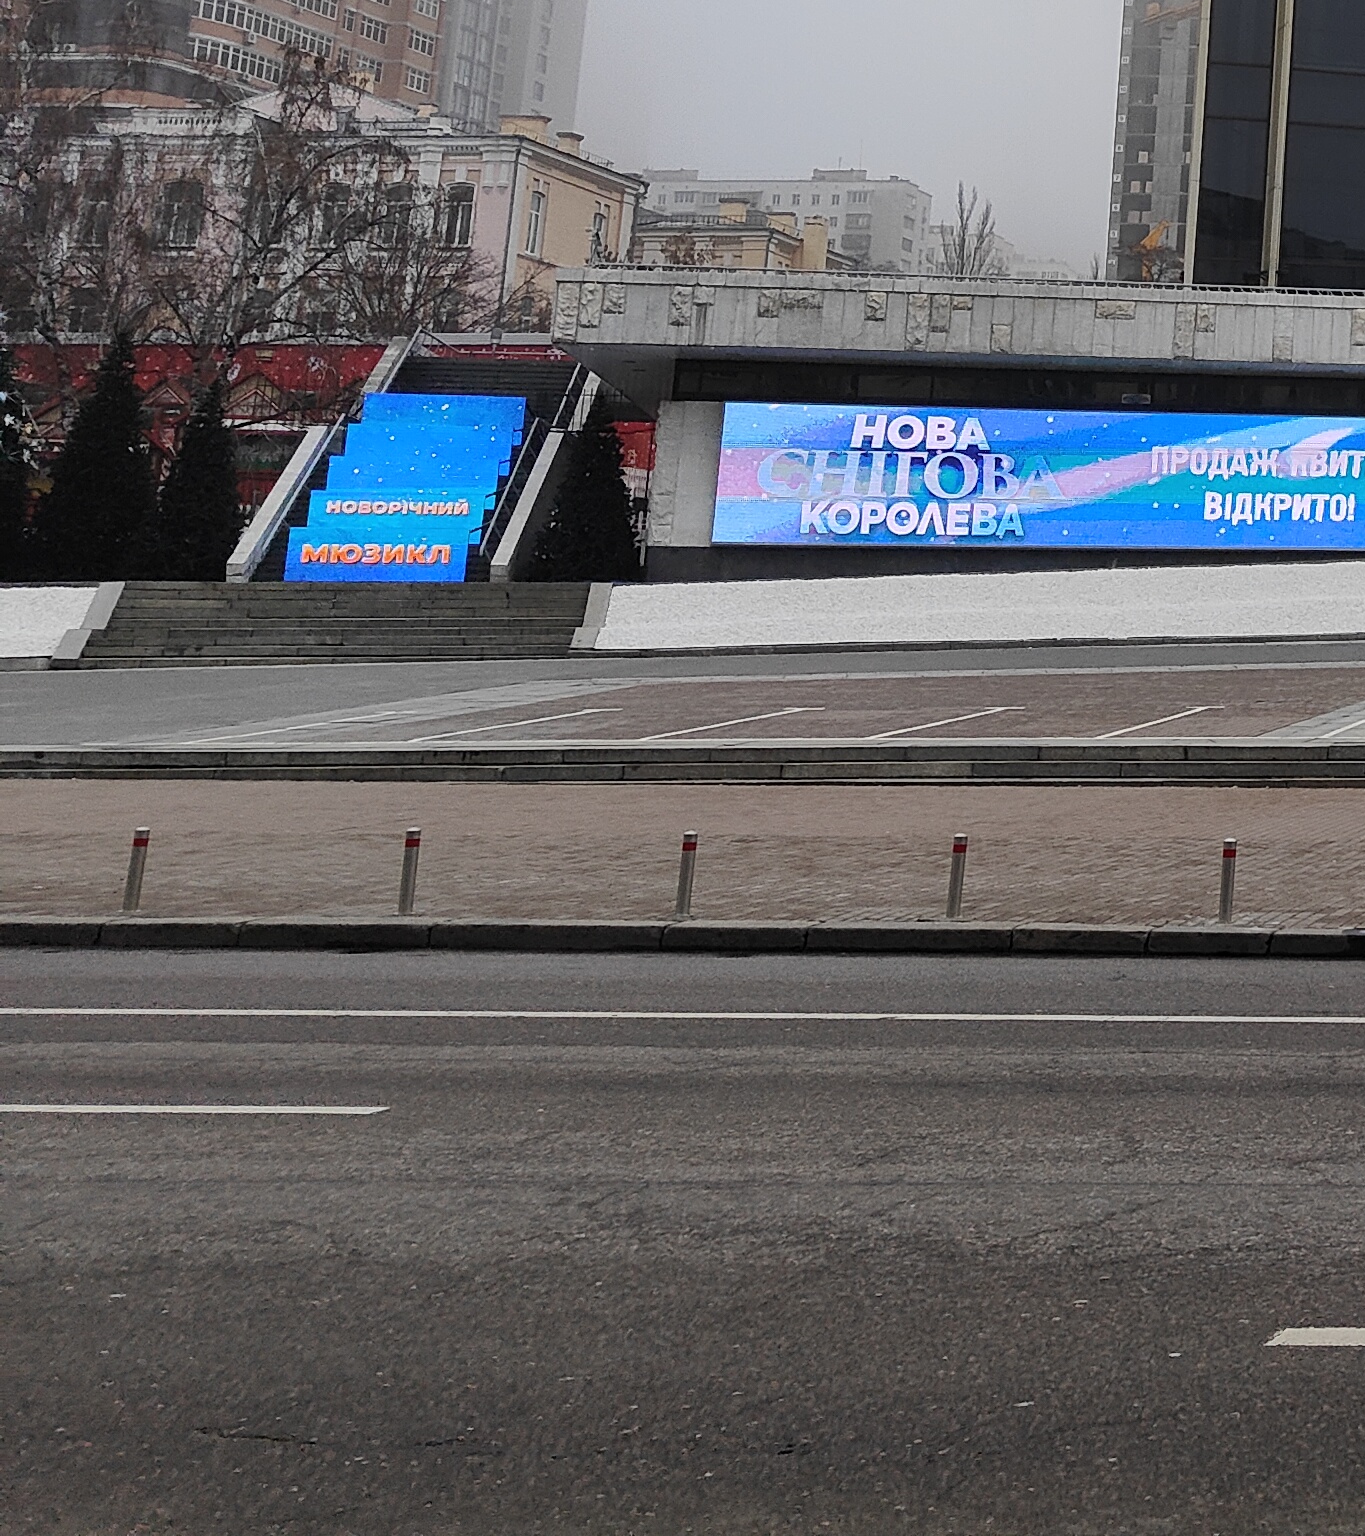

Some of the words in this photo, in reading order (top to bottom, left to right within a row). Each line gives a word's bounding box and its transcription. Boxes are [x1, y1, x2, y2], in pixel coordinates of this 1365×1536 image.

[850, 415, 991, 451] НОВА
[757, 449, 1072, 500] СНІГОВА
[1151, 445, 1280, 480] ПРОДАЖ
[325, 498, 470, 516] НОВОРІЧНИЙ
[799, 500, 1025, 537] КОРОЛЕВА
[1203, 491, 1356, 526] ВІДКРИТО!
[301, 543, 451, 565] МЮЗИКЛ
